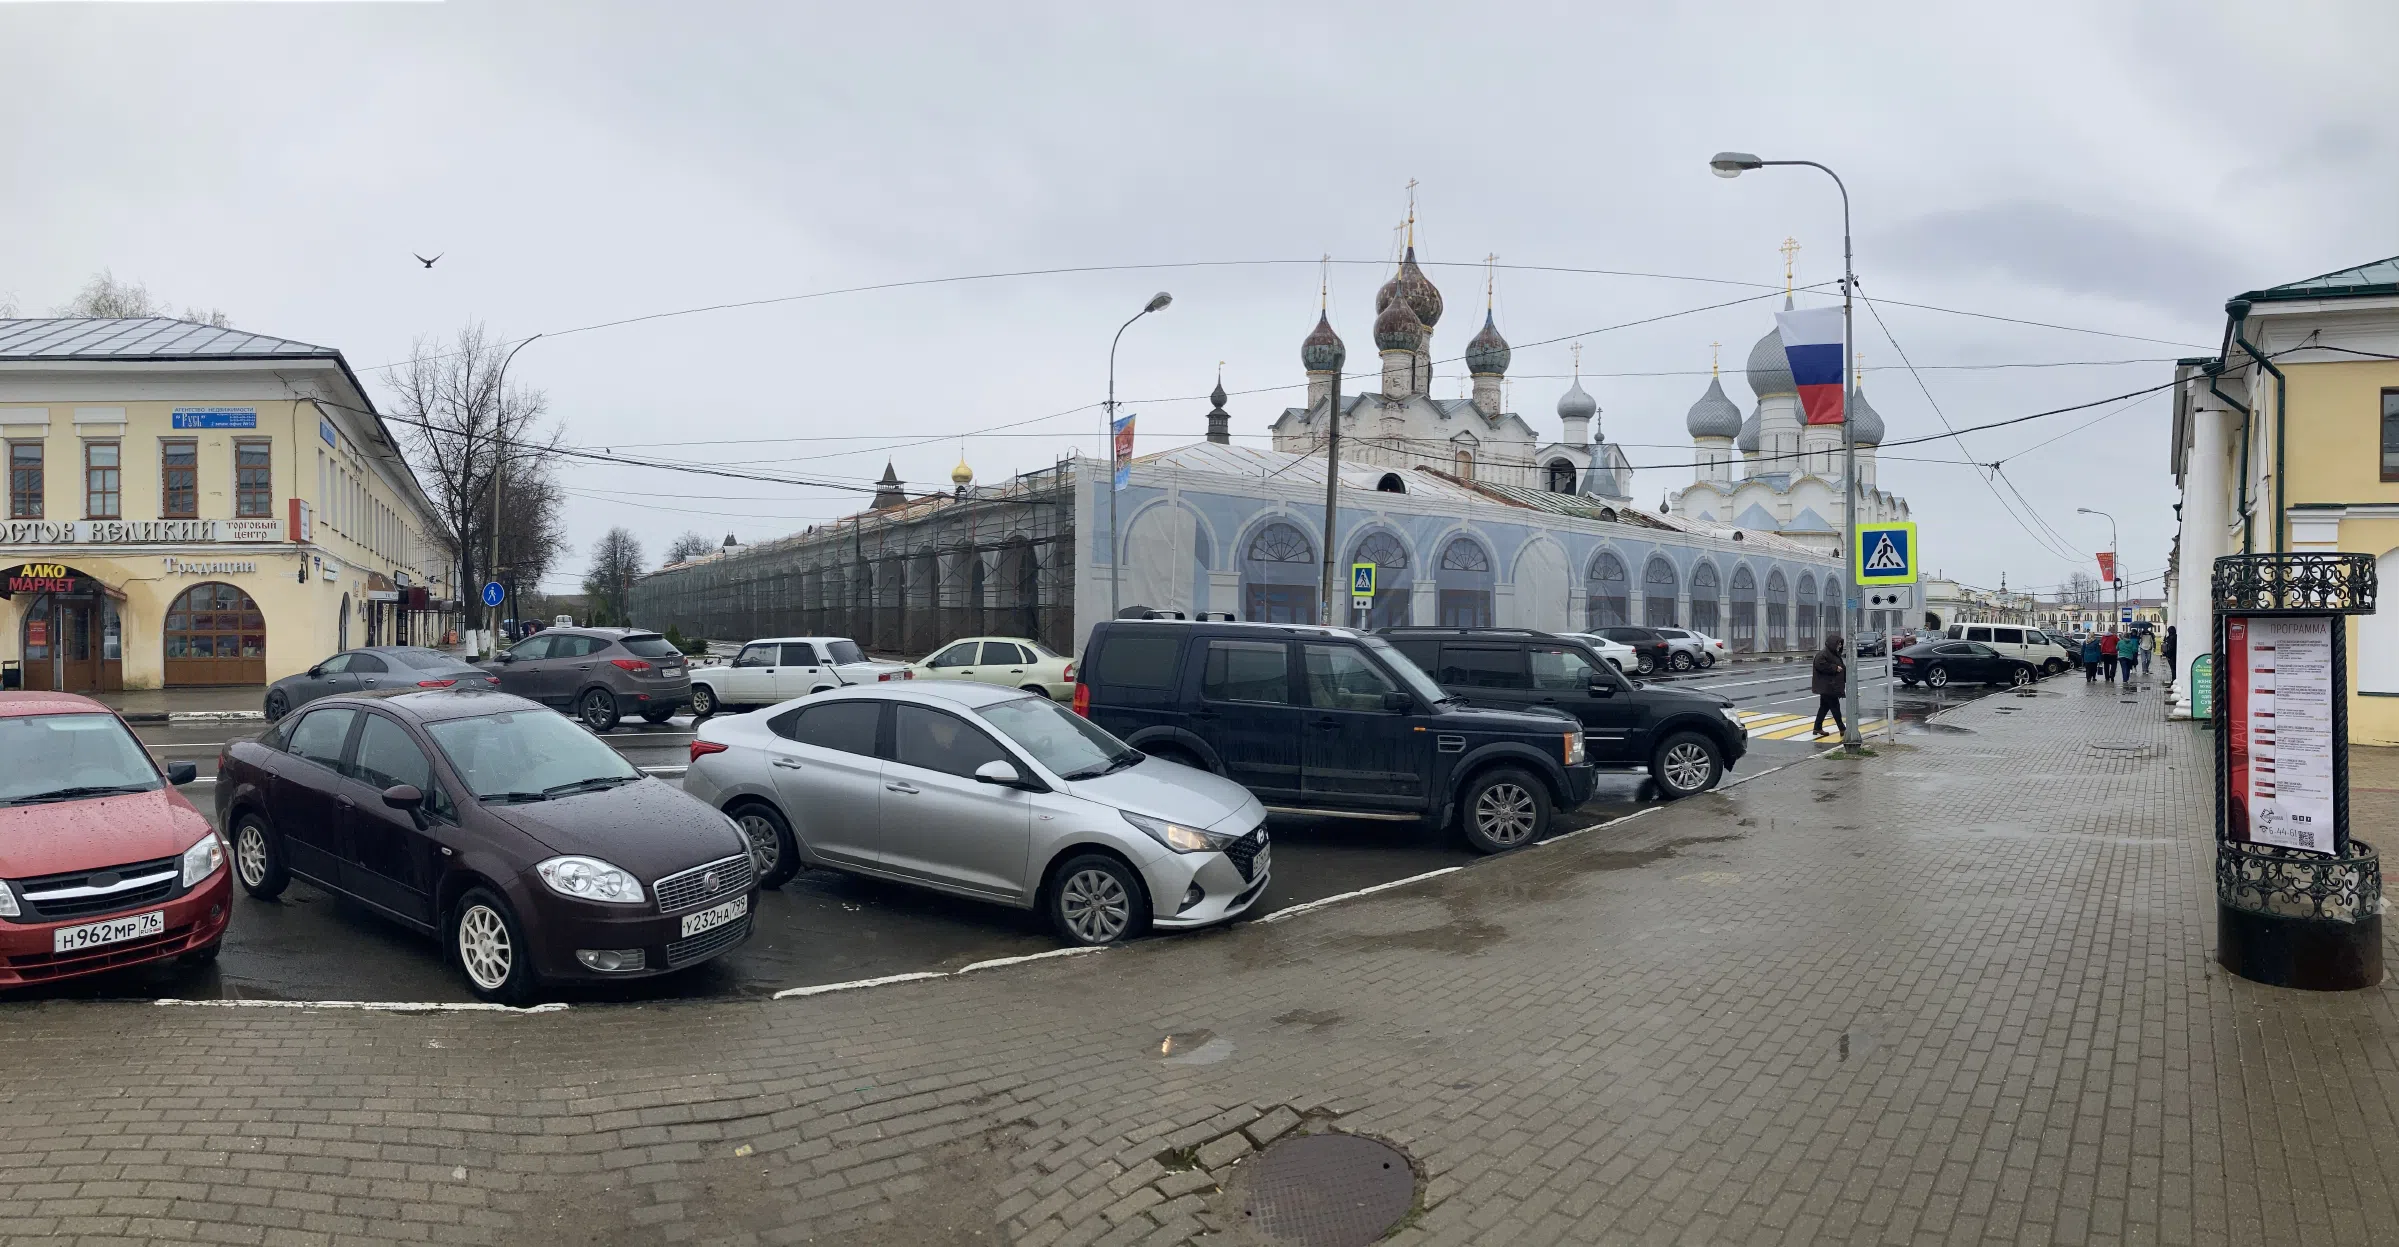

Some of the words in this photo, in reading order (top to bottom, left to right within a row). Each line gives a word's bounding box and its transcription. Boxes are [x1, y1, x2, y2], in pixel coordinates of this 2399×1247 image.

[234, 531, 268, 540] ЦЕНТР
[21, 564, 66, 578] АЛКО
[9, 577, 75, 592] МАРКЕТ
[2270, 623, 2327, 635] ПРОГРАММА
[2230, 719, 2248, 756] МАЙ
[687, 909, 729, 933] У232НА
[731, 896, 746, 914] 799
[64, 923, 136, 948] Н962МР
[141, 915, 157, 929] 76
